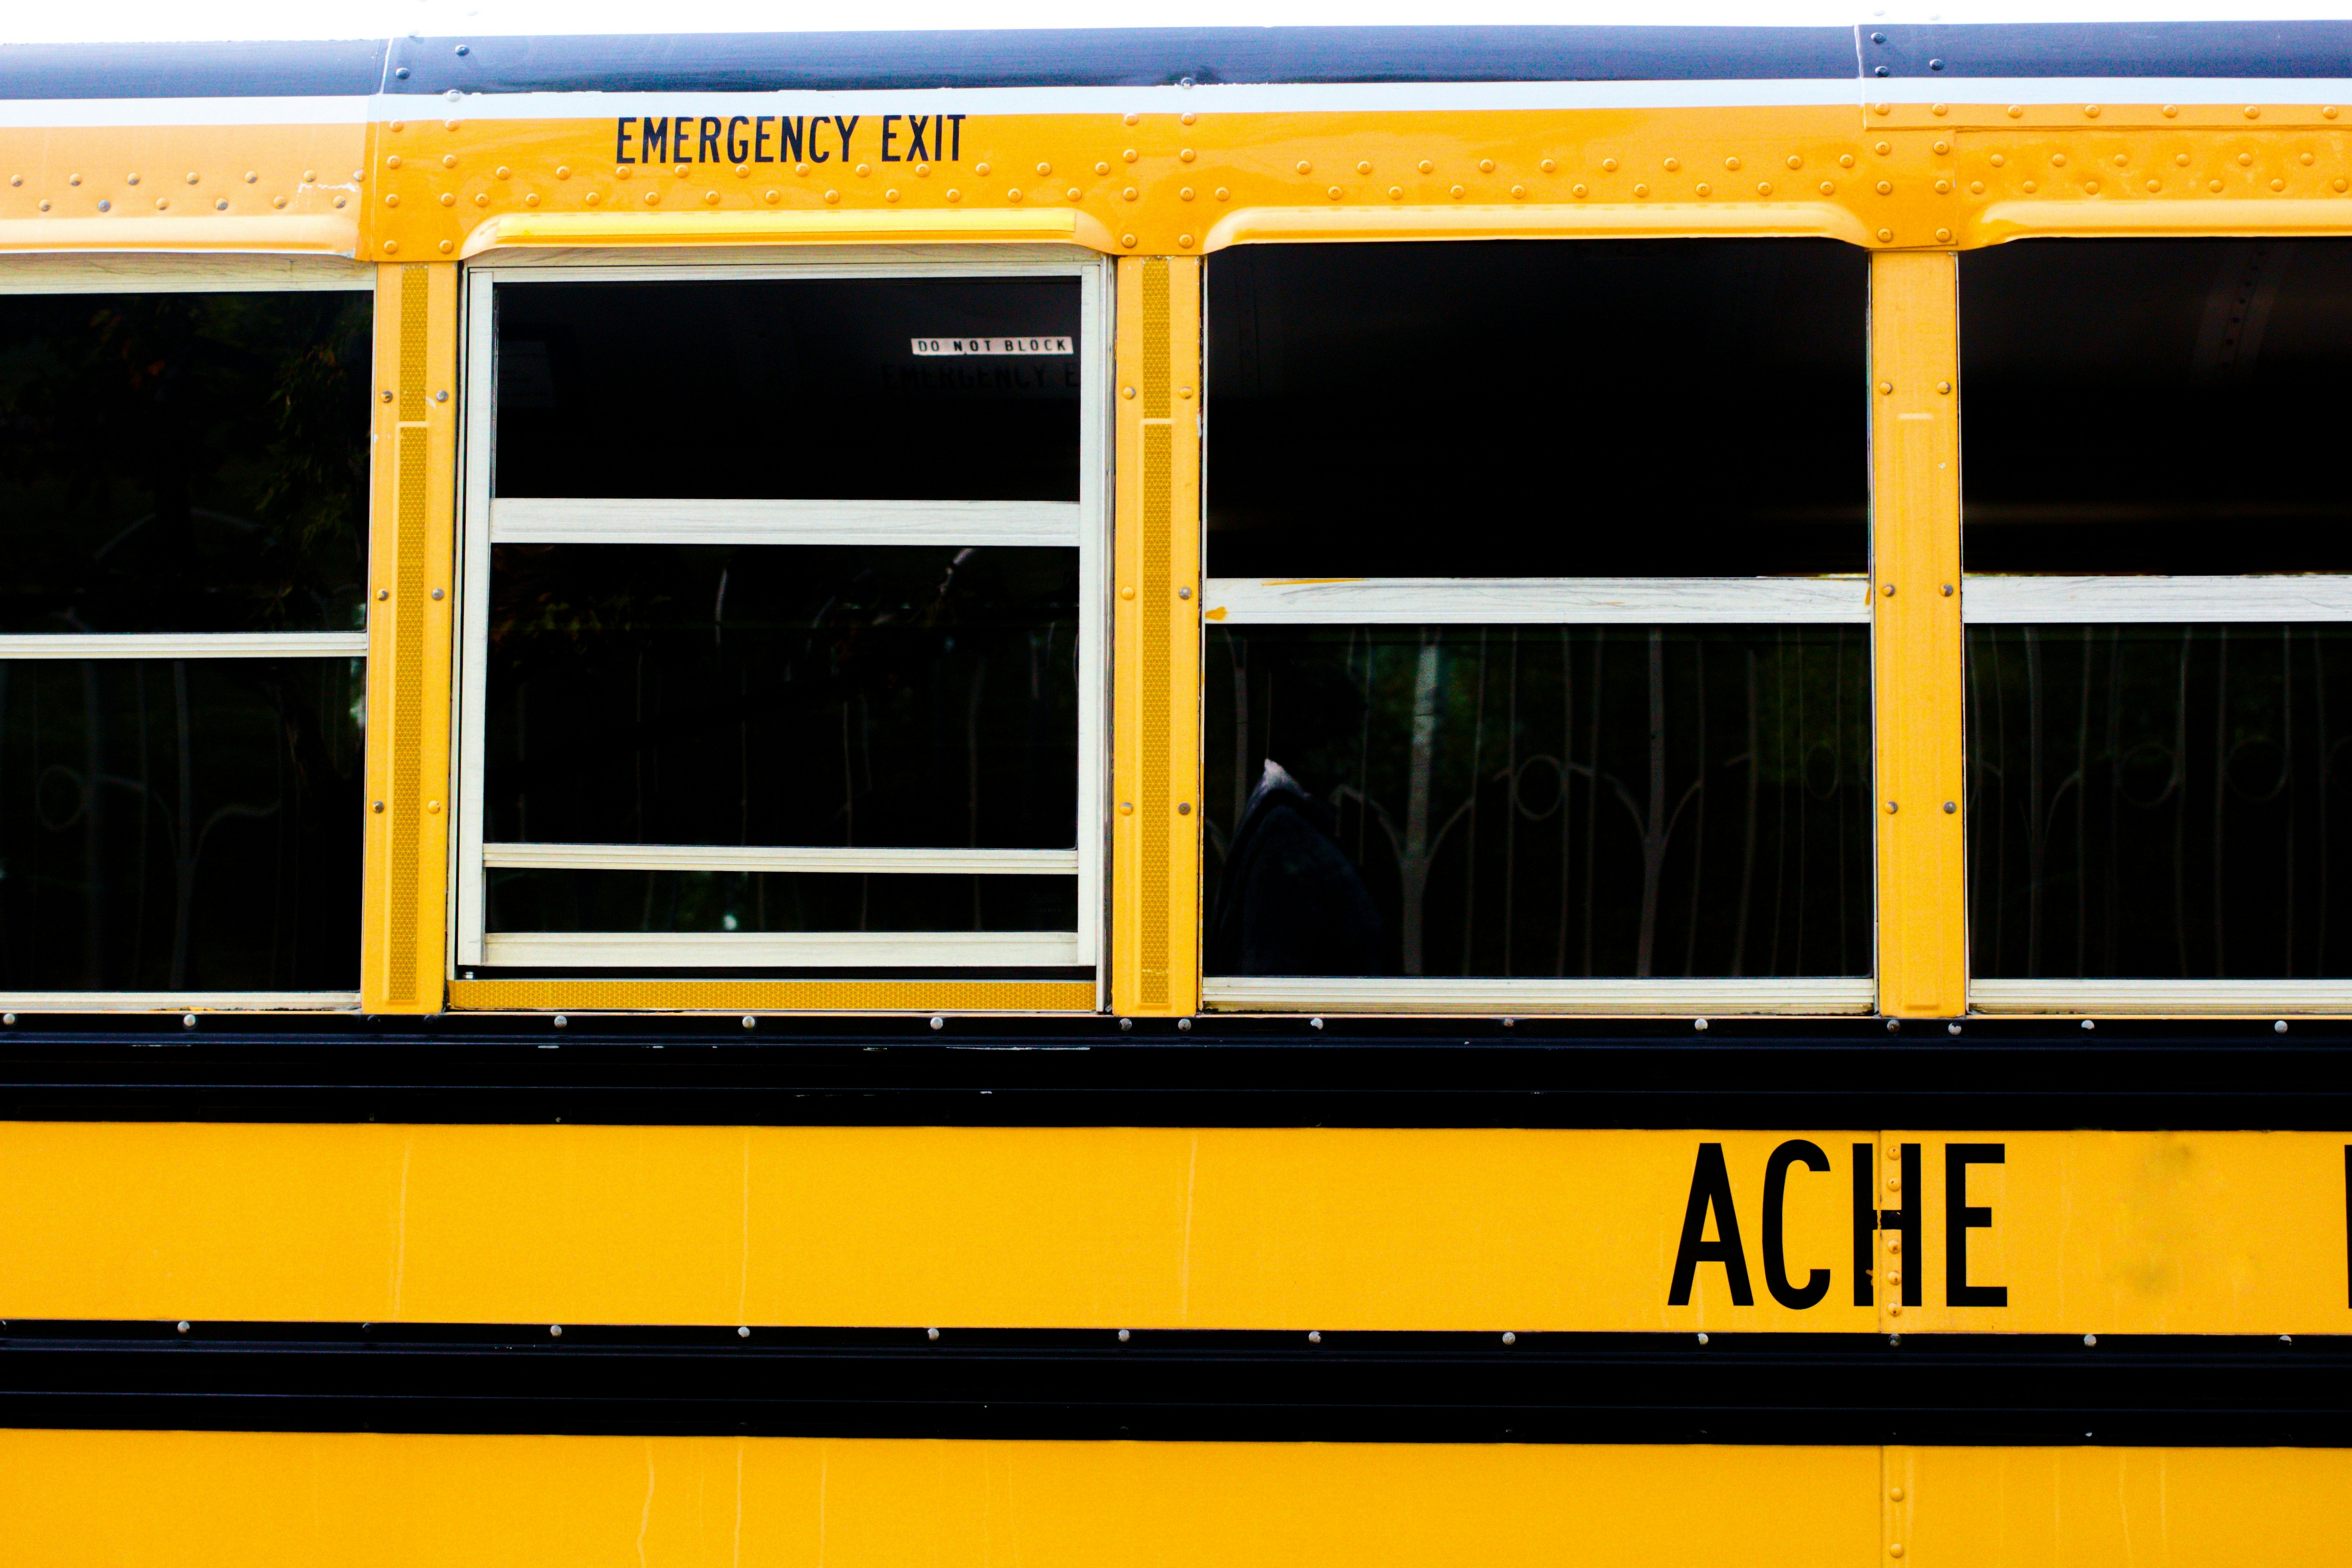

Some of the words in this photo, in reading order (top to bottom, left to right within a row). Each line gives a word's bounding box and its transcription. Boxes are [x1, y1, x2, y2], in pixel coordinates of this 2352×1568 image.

[616, 116, 860, 163] EMERGENCY
[882, 115, 966, 162] EXIT
[918, 340, 939, 351] DO
[954, 339, 990, 351] NOT
[1005, 339, 1066, 351] BLOCK
[1668, 1139, 2008, 1310] ACHE
